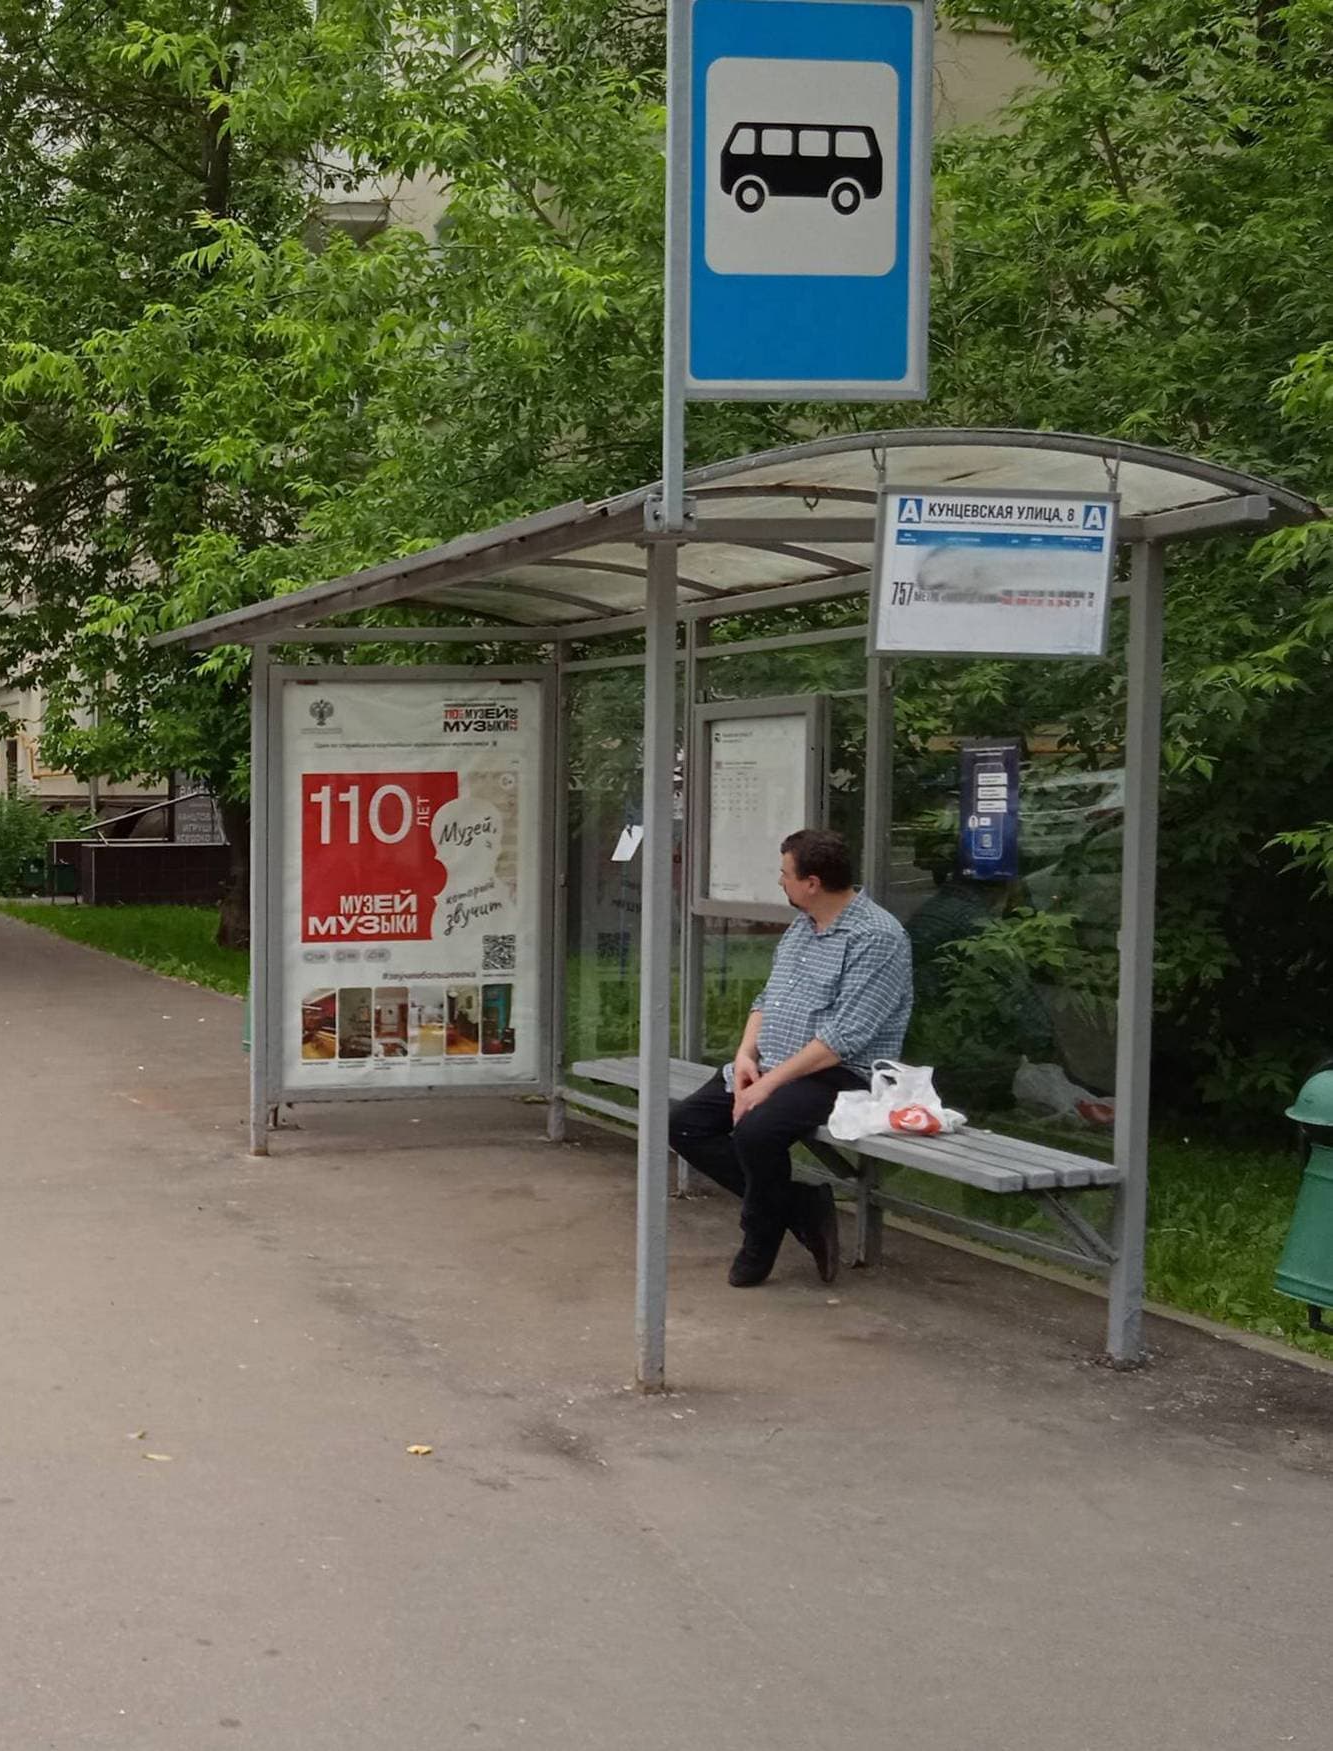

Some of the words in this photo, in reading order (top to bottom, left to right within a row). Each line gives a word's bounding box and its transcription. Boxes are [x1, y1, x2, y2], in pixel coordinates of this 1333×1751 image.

[928, 502, 1013, 520] КУНЦЕВСКАЯ
[1017, 507, 1063, 522] УЛИЦА,
[1067, 508, 1075, 522] 8
[891, 581, 914, 606] 757
[310, 784, 413, 844] 110
[416, 796, 431, 827] ЛЕТ
[340, 890, 416, 914] МУЗЕЙ
[308, 914, 417, 935] МУЗЫКИ
[444, 902, 502, 936] звучит
